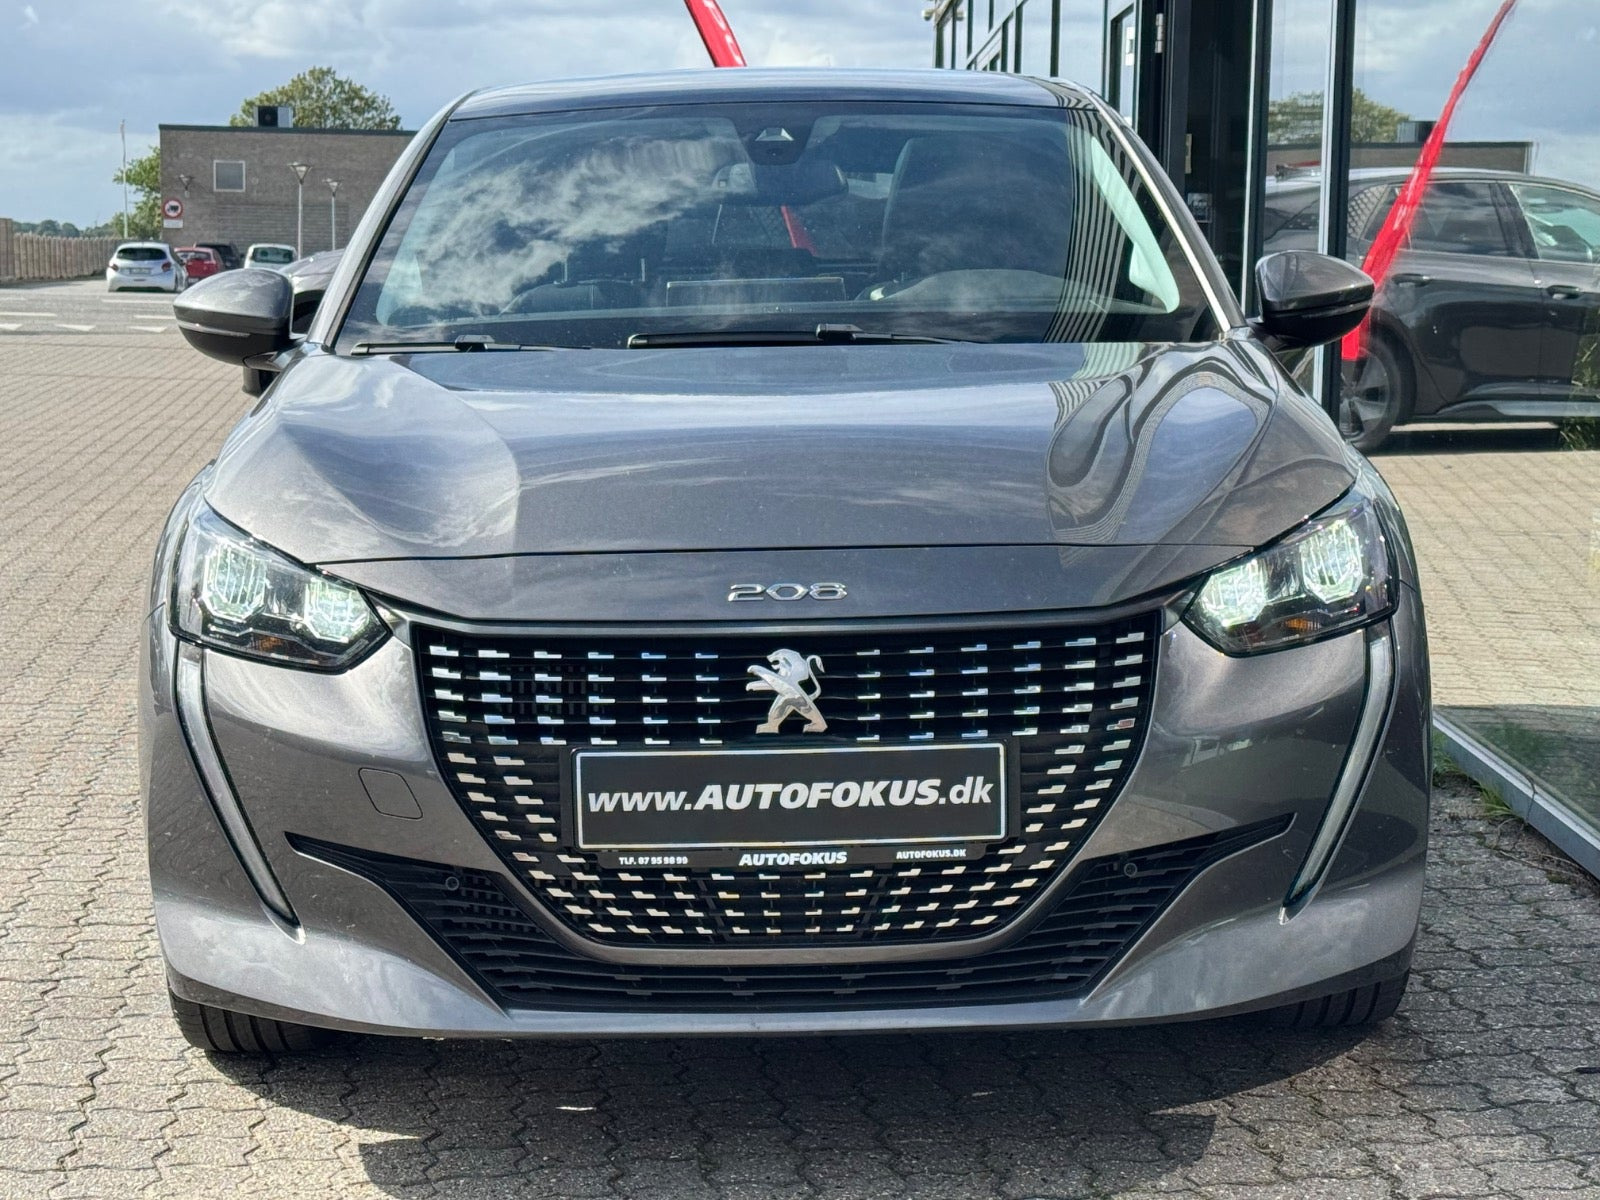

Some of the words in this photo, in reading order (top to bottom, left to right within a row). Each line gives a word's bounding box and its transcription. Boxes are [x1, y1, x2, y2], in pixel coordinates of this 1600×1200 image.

[728, 582, 848, 601] 208
[588, 776, 994, 812] www.AUTOFOKUS.dk
[738, 851, 848, 866] AUTOFOKUS
[896, 849, 967, 860] AUTOFOKUS.DK
